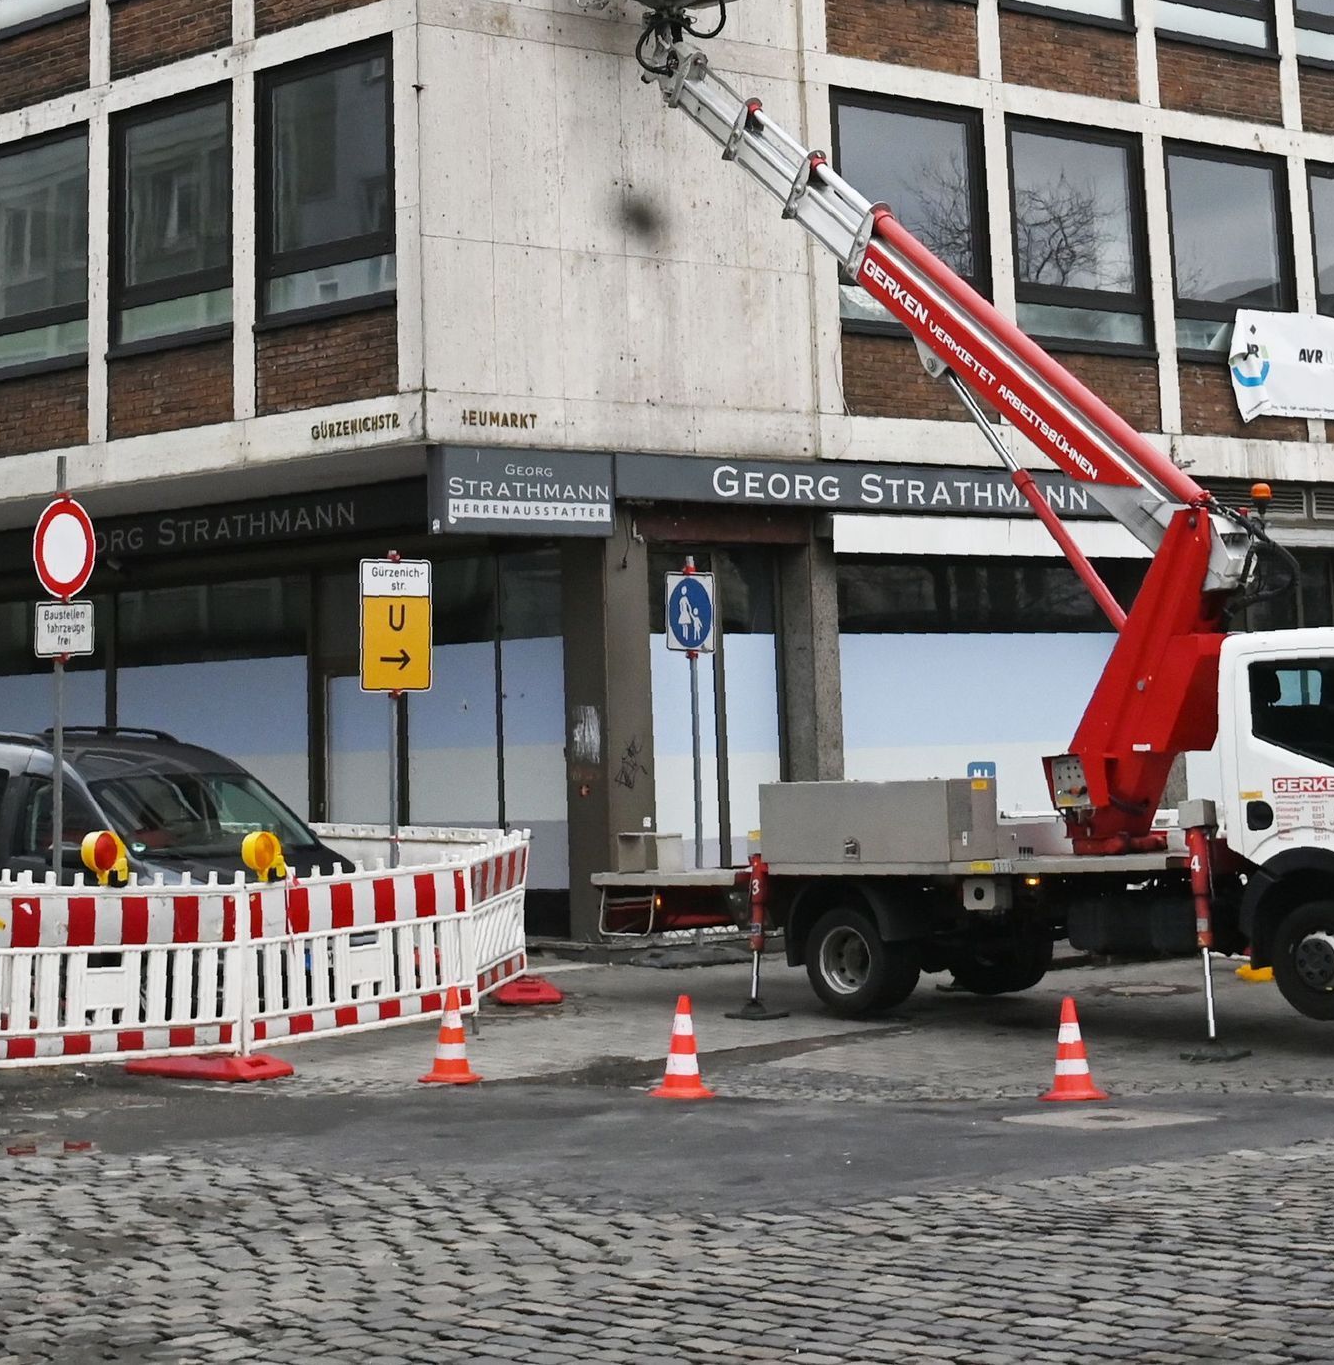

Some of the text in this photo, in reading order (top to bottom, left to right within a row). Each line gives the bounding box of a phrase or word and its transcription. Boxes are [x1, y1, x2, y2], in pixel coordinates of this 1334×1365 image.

[1298, 347, 1323, 364] AVR
[863, 257, 1099, 481] GERKEN VERMIETET ARBEITSBÜHNEN
[448, 477, 610, 501] STRATHMANN
[712, 465, 1090, 511] GEORG STRATHMNN
[452, 502, 606, 518] HERRENAUSSTATTER
[157, 501, 356, 547] STRATHMANN
[371, 565, 425, 581] Gürzenich-
[391, 580, 408, 592] str.
[1189, 856, 1202, 872] 4
[751, 878, 760, 895] 3
